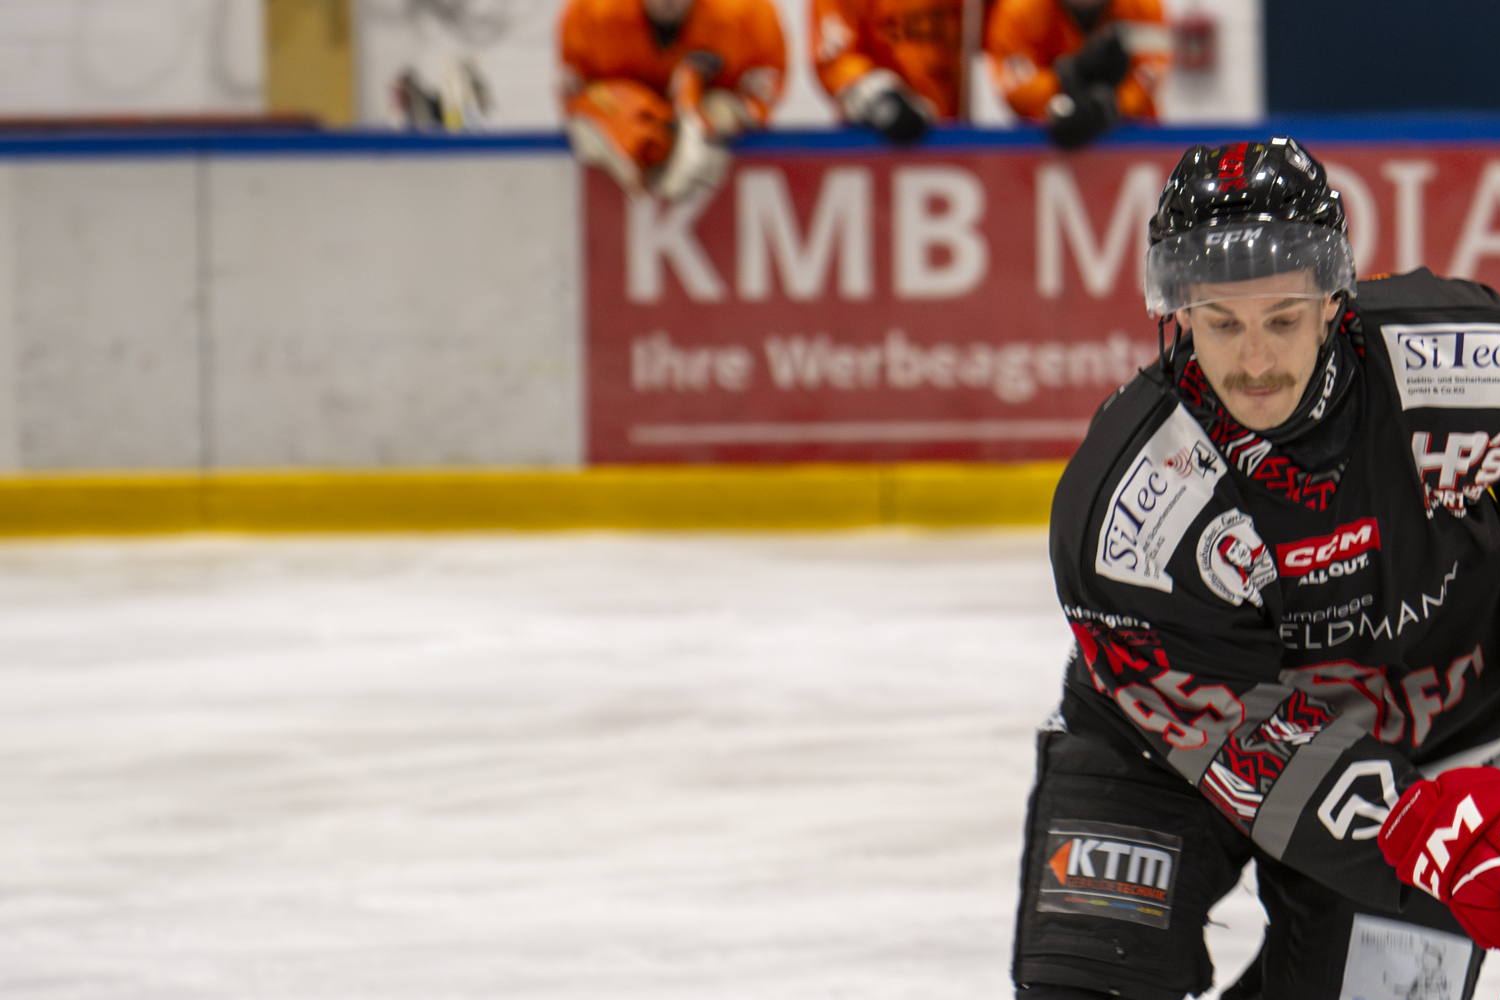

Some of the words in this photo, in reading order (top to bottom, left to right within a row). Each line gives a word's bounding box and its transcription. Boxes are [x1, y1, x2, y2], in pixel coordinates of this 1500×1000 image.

[626, 165, 990, 302] KMB
[1205, 226, 1264, 246] CCM
[629, 330, 753, 391] Ihre
[1284, 524, 1373, 568] CCM
[1279, 559, 1459, 650] ELDMANN
[1281, 593, 1374, 624] umpflege
[1066, 837, 1173, 891] KTM
[1412, 793, 1484, 901] CM
